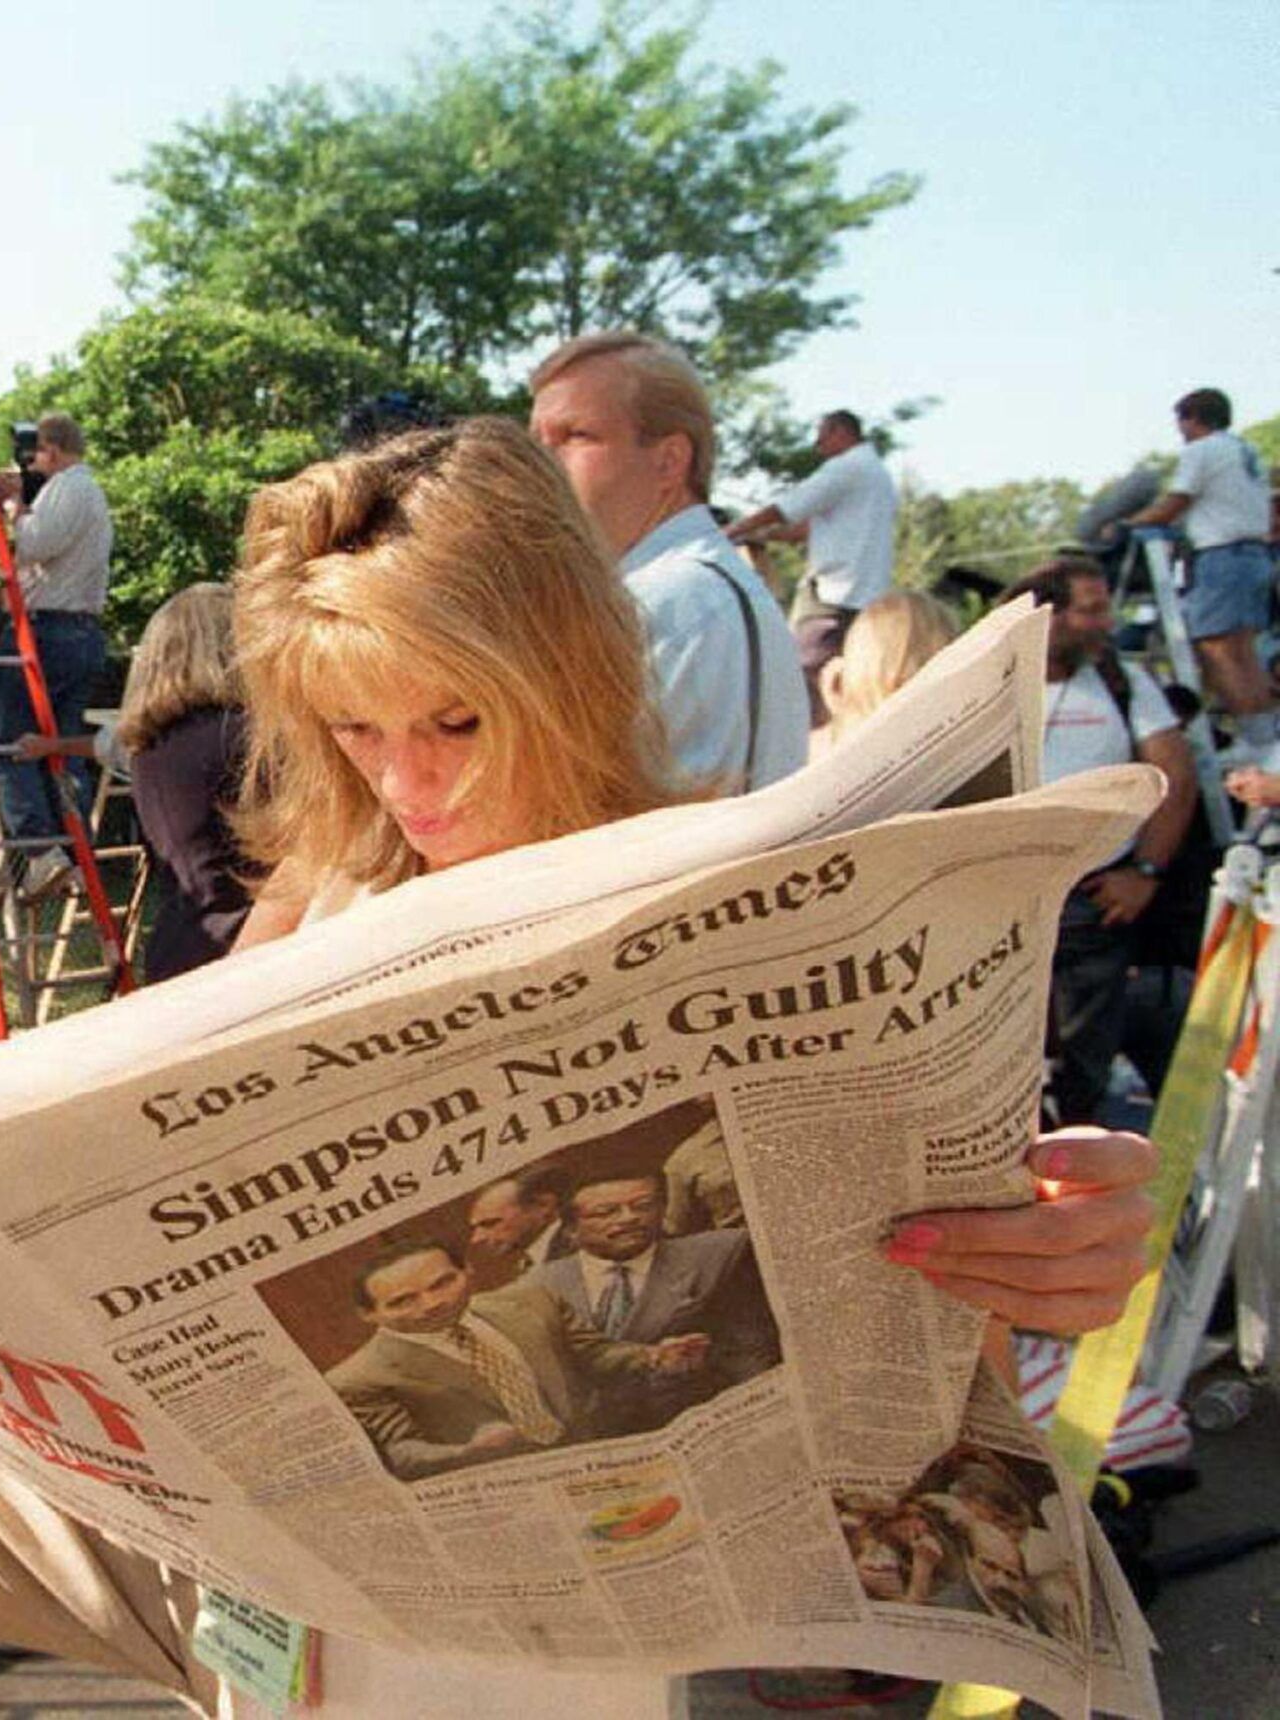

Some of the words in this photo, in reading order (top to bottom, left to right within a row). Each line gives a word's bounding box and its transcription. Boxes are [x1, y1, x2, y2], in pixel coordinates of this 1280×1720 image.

[91, 1230, 277, 1321] Drama
[283, 1166, 421, 1241] Ends
[431, 1114, 531, 1178] 474
[539, 1065, 683, 1132] Days
[699, 1027, 855, 1076] After
[874, 921, 1025, 1044] Arrest
[139, 1071, 276, 1138] Los
[293, 968, 590, 1087] Angeles
[613, 849, 856, 971] Times
[149, 1086, 483, 1243] Simpson
[497, 1018, 651, 1098] Not
[667, 923, 929, 1036] Guilty
[112, 1338, 166, 1364] Case
[167, 1314, 220, 1345] Had
[128, 1353, 193, 1386] Many
